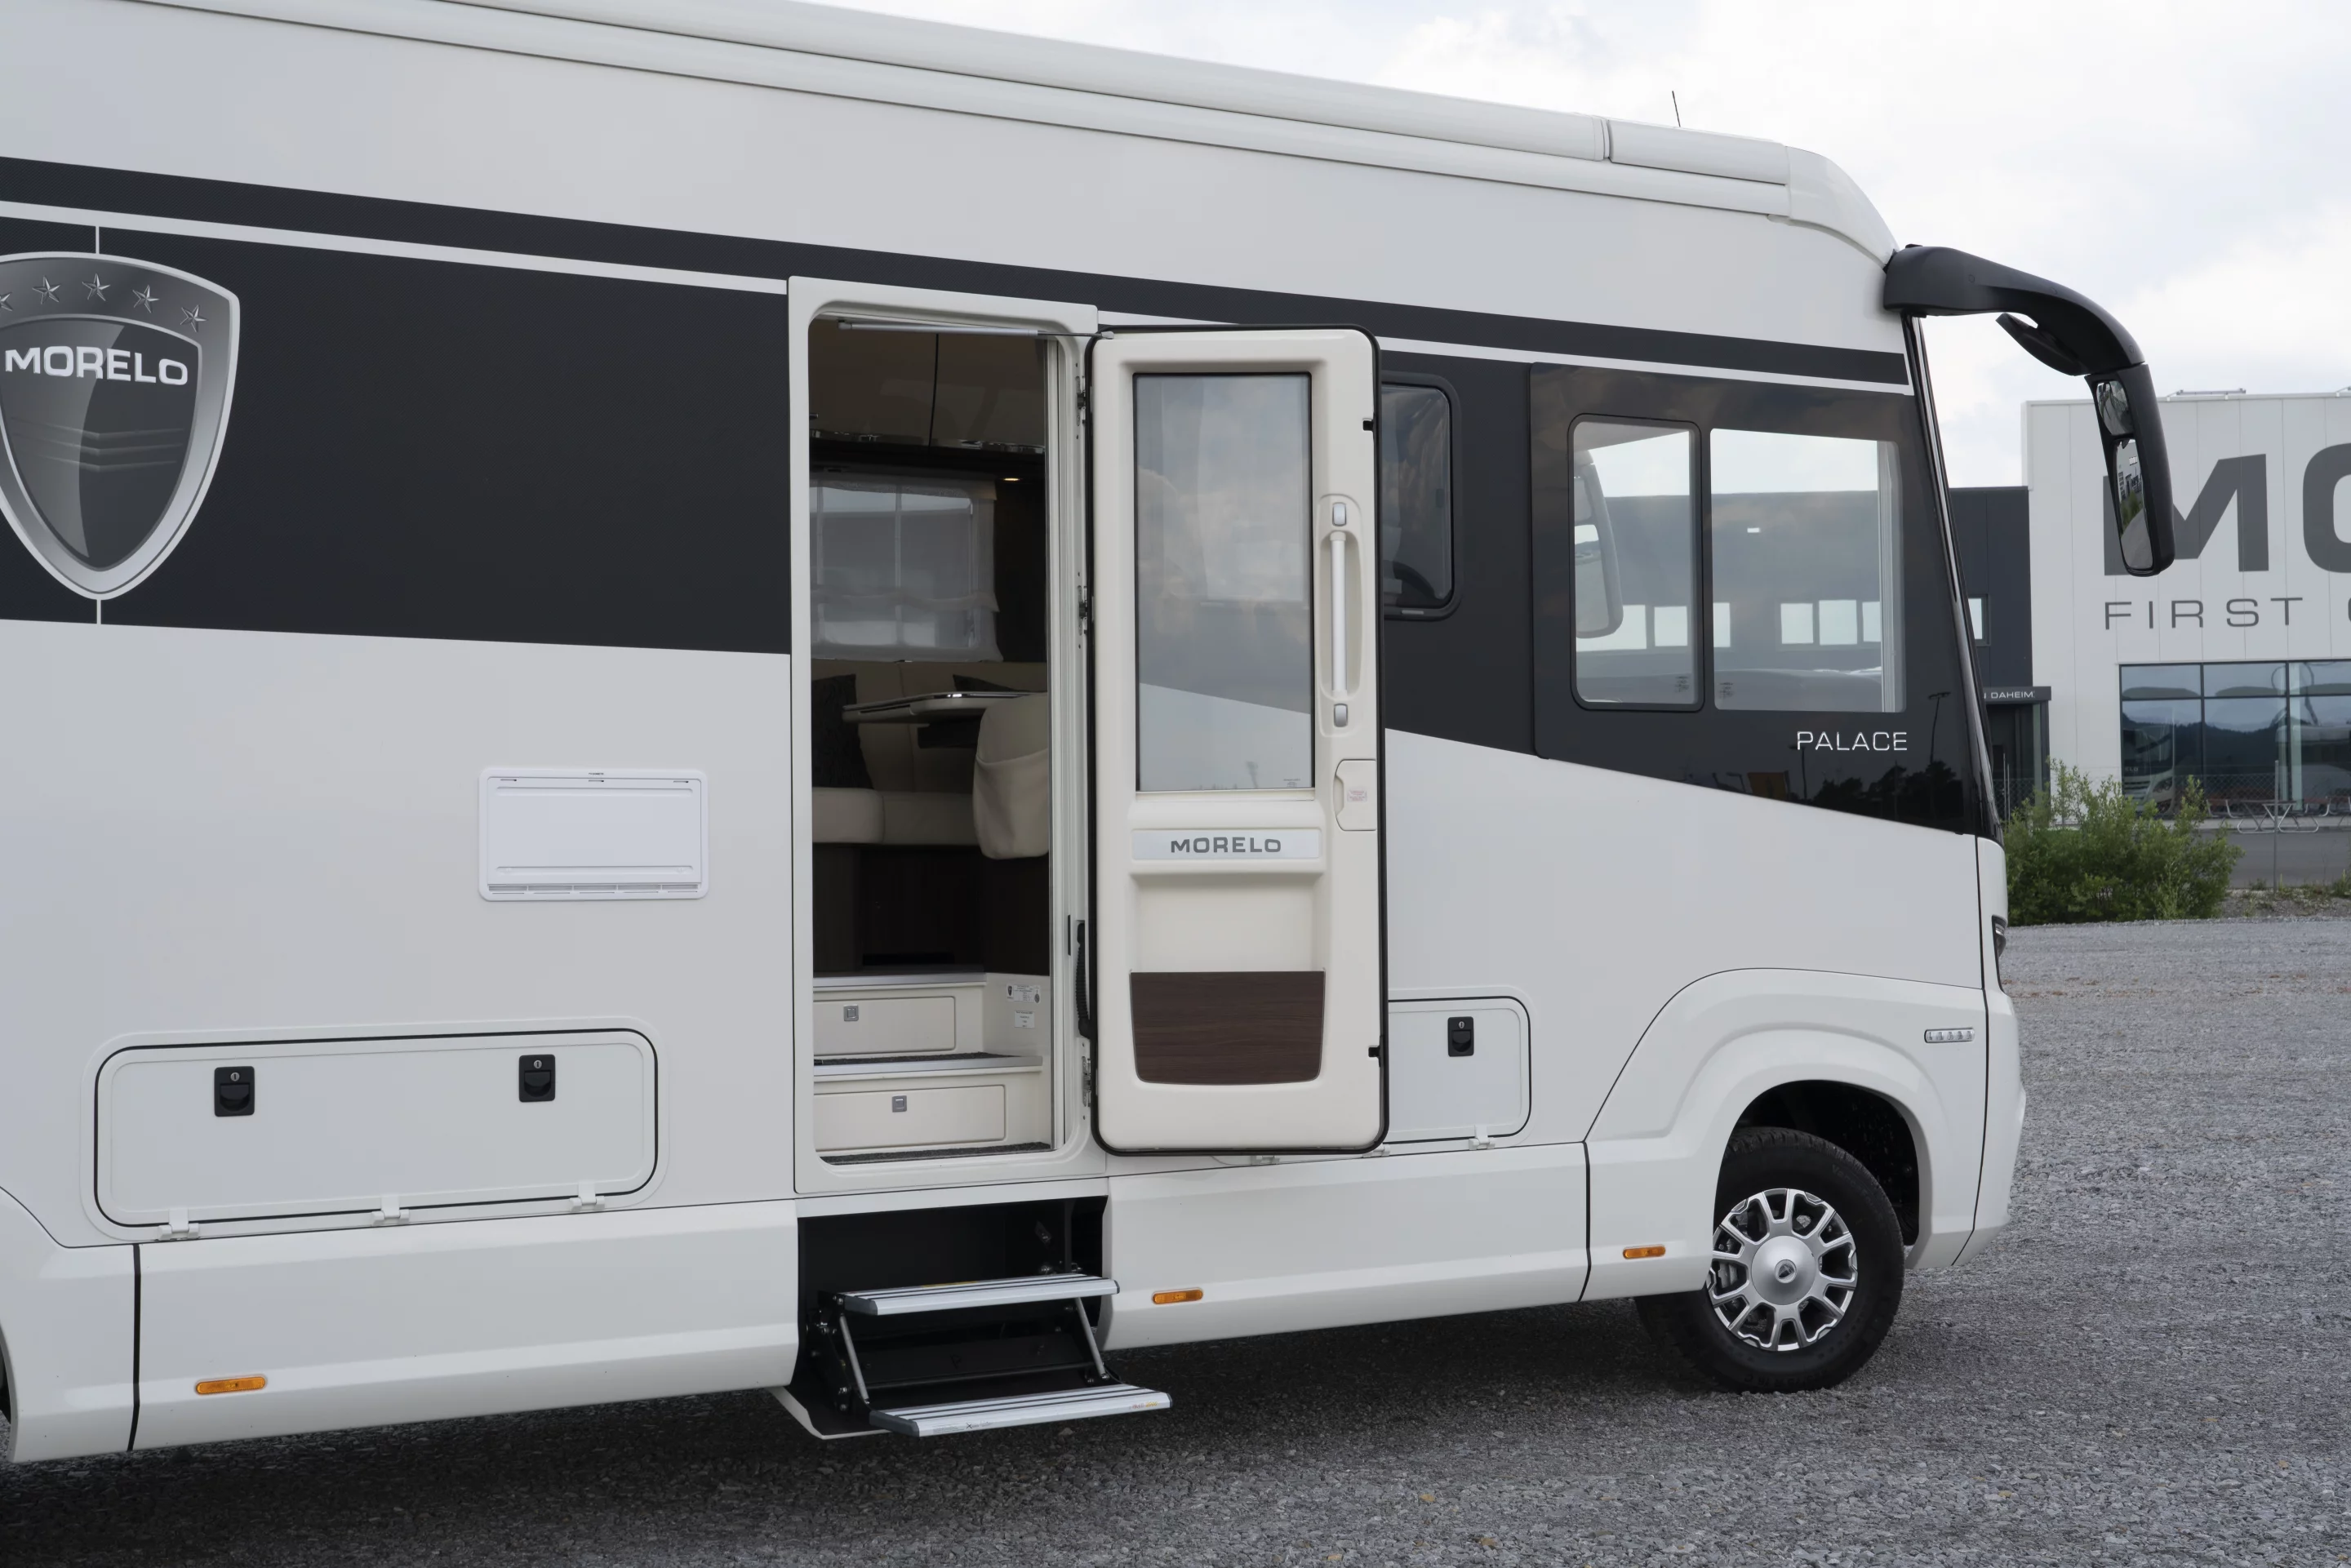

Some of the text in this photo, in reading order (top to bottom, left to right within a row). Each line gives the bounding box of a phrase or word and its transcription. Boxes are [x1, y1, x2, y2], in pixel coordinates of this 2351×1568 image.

[5, 345, 189, 385] MORELO
[2104, 597, 2303, 630] FIRST
[1797, 731, 1908, 751] PALACE
[1171, 837, 1282, 854] MORELO
